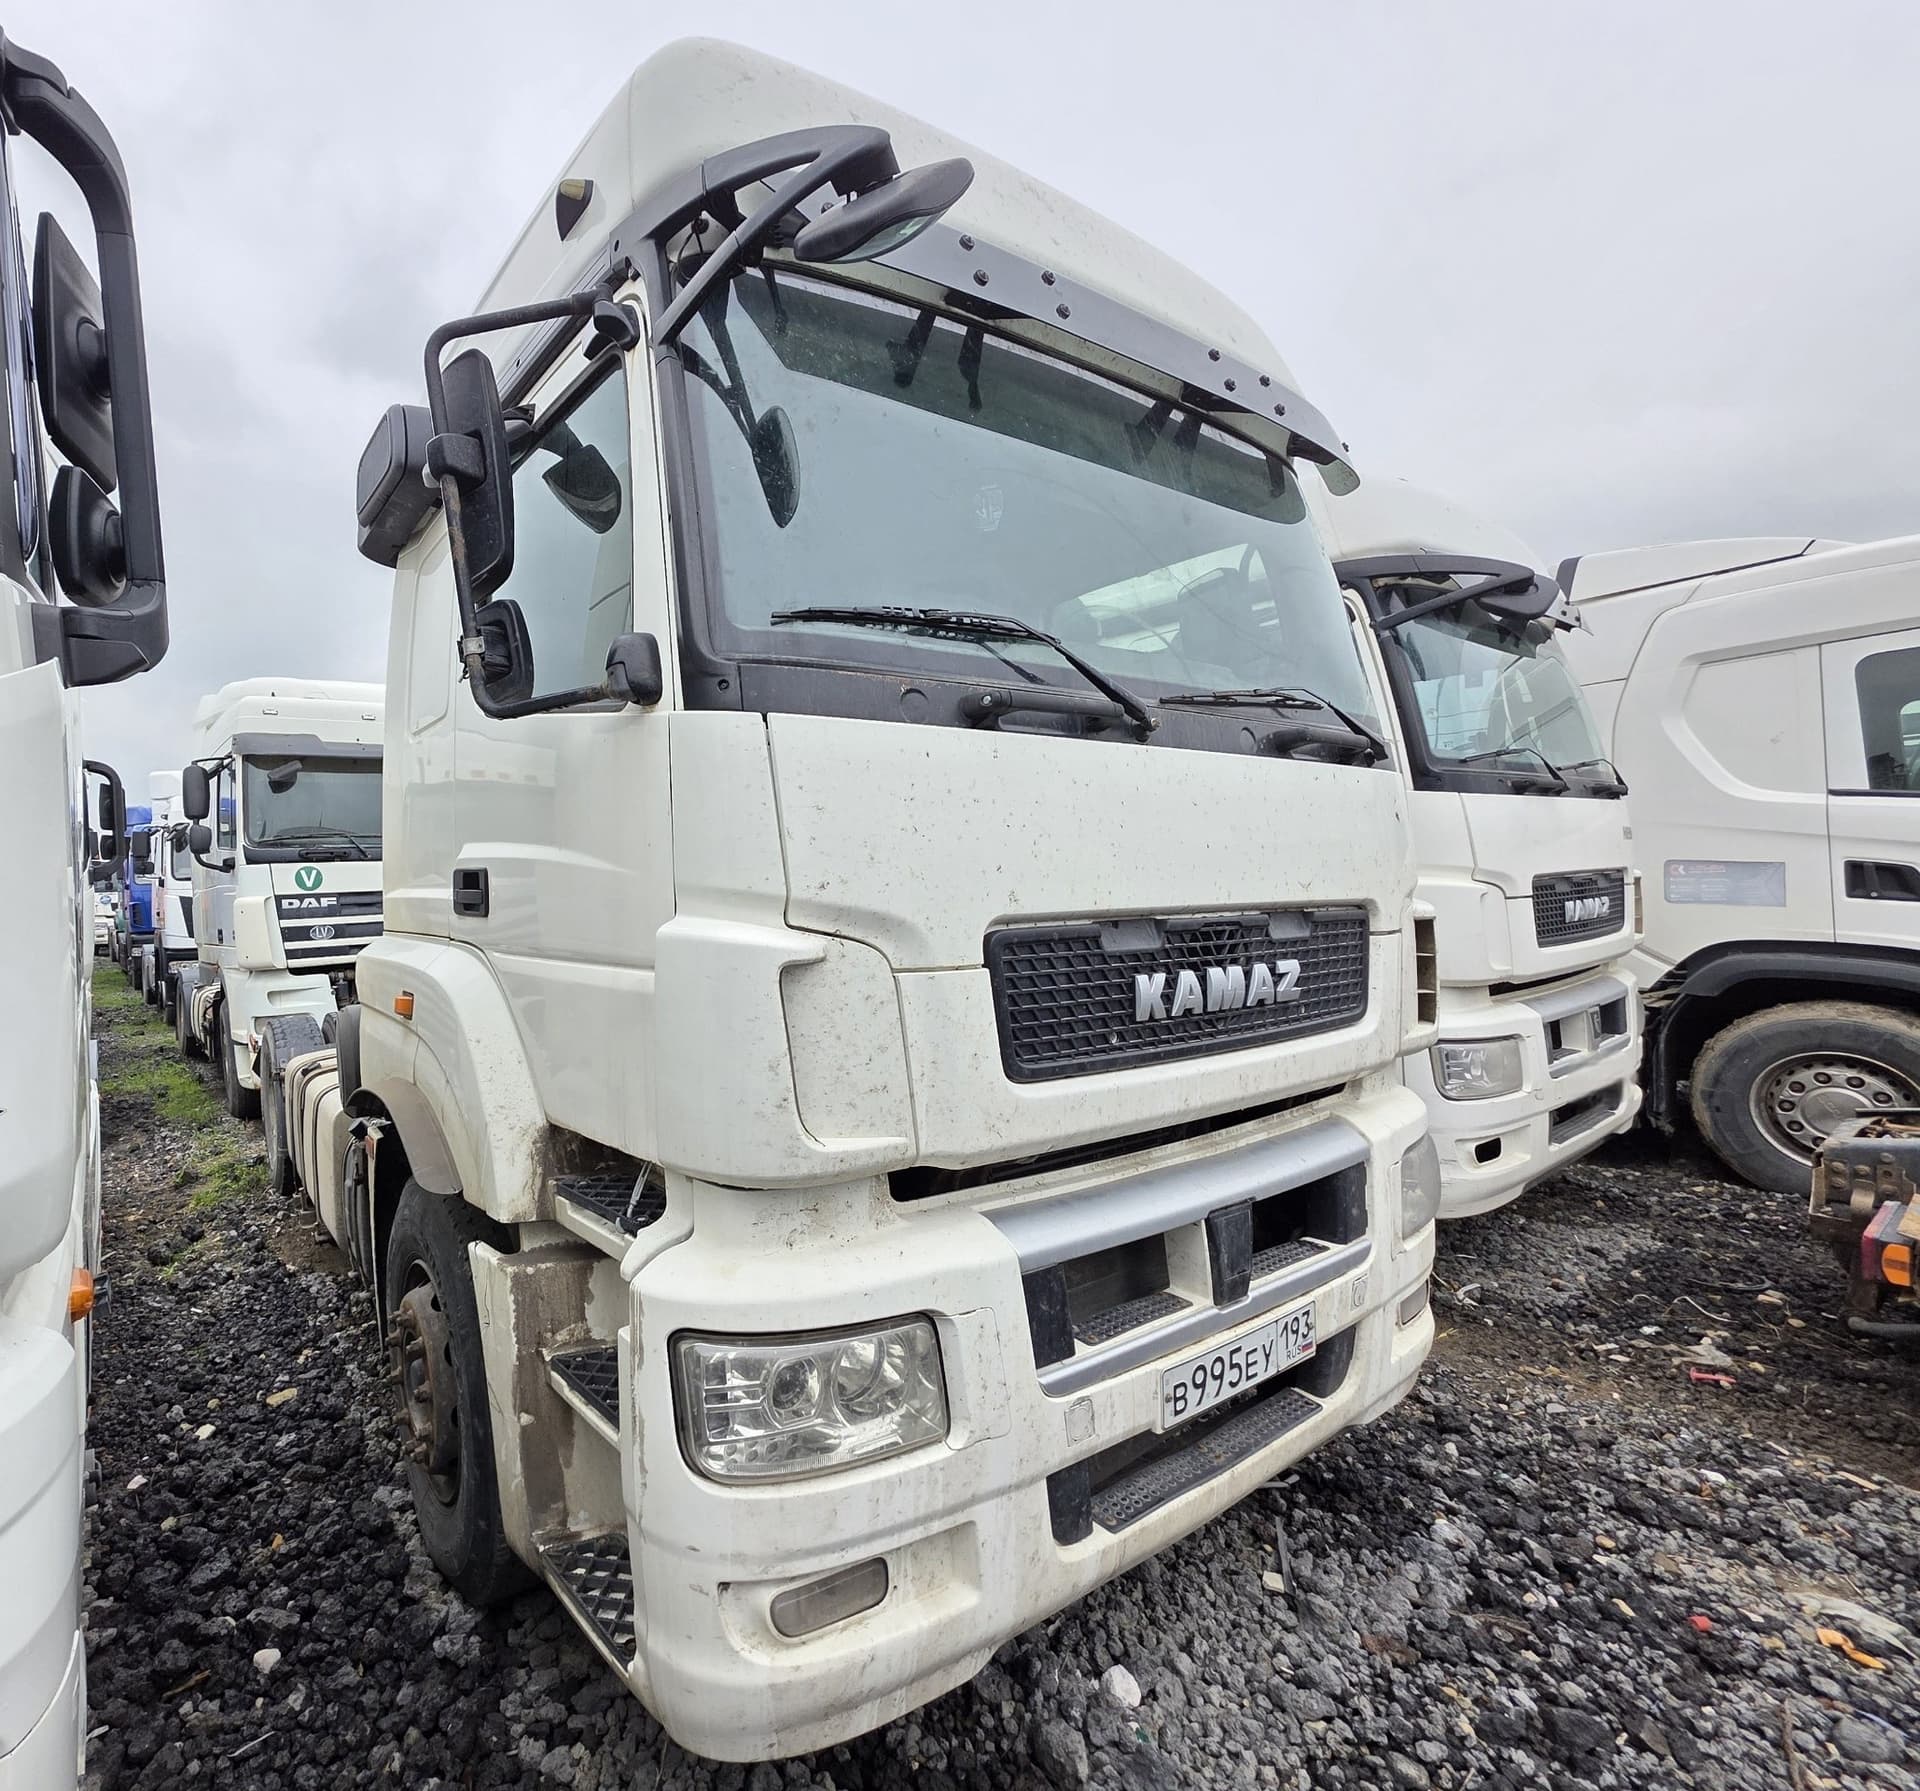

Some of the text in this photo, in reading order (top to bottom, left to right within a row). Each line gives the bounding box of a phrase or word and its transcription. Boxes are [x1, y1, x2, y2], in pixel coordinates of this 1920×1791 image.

[299, 869, 318, 888] V
[281, 896, 337, 909] DAF
[1134, 958, 1302, 1022] KAMAZ
[1280, 1309, 1311, 1350] 193
[1286, 1345, 1302, 1361] RUS
